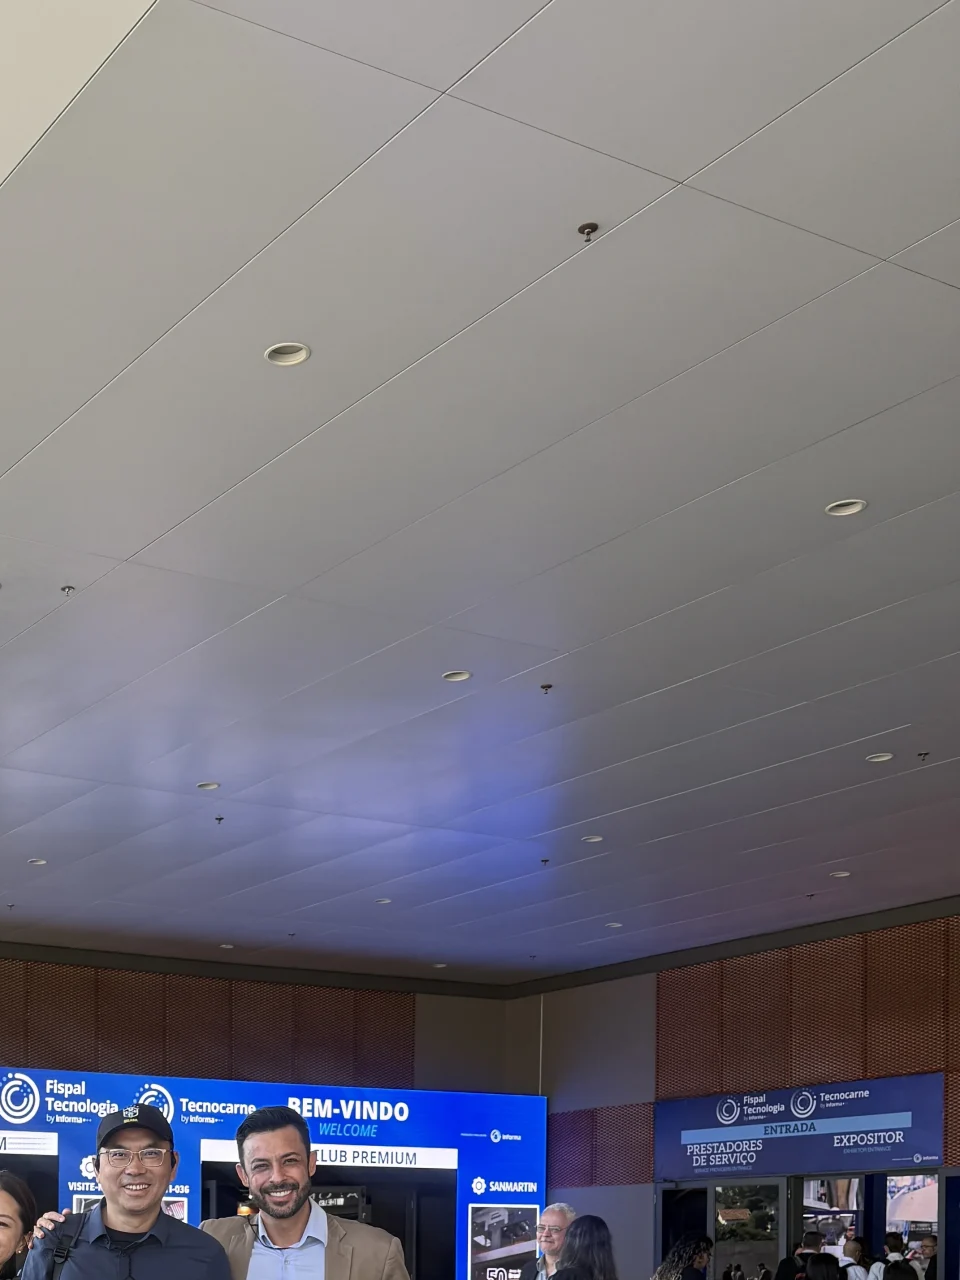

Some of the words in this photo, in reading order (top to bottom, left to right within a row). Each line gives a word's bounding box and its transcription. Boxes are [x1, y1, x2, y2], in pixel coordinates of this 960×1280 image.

[45, 1078, 85, 1098] Fispal
[820, 1089, 870, 1101] Tecnocarne
[179, 1098, 257, 1116] Tecnocarne
[743, 1093, 766, 1106] Fispal
[44, 1098, 119, 1118] Tecnologia
[288, 1097, 409, 1122] BEM-VINDO
[742, 1102, 785, 1115] Tecnologia
[46, 1114, 55, 1124] by
[180, 1114, 189, 1124] by
[319, 1122, 379, 1138] WELCOME
[763, 1122, 816, 1136] ENTRADA
[833, 1130, 905, 1147] EXPOSITOR
[686, 1139, 763, 1156] PRESTADORES
[353, 1150, 417, 1166] PREMIUM
[692, 1155, 707, 1167] DE
[709, 1152, 757, 1165] SERVIÇO
[489, 1181, 538, 1193] SANMARTIN
